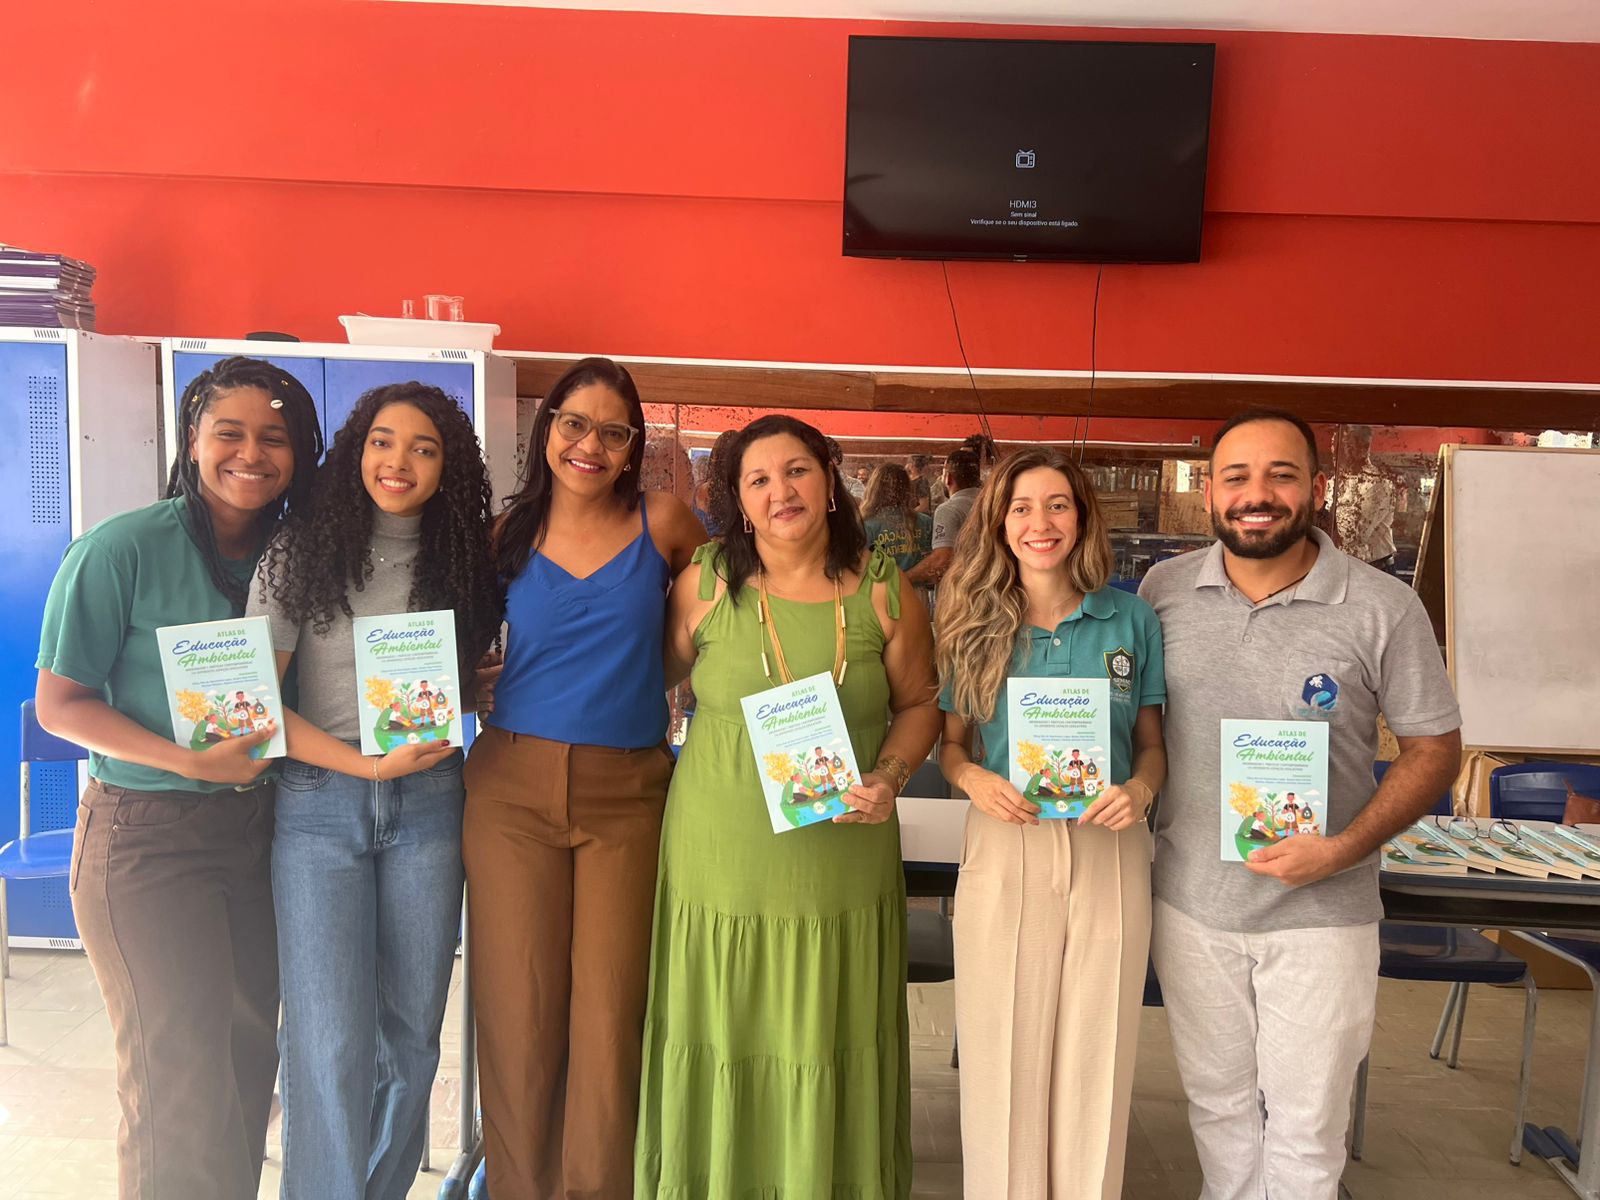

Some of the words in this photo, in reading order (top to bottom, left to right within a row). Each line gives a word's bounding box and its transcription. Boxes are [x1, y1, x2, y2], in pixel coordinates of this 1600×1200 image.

[1009, 200, 1037, 209] HDMI3
[970, 218, 994, 226] Verifique
[1018, 219, 1048, 227] dispositivo
[408, 620, 426, 628] ATLAS
[217, 629, 237, 638] ATLAS
[237, 628, 246, 636] DE
[366, 627, 436, 643] Educação
[172, 637, 248, 656] Educação
[369, 638, 443, 656] Ambiental
[177, 647, 257, 668] Ambiental
[791, 687, 808, 698] ATLAS
[1020, 692, 1090, 708] Educação
[756, 693, 818, 720] Educação
[1022, 706, 1098, 719] Ambiental
[761, 702, 828, 731] Ambiental
[1233, 733, 1307, 751] Educação
[1236, 747, 1315, 762] Ambiental
